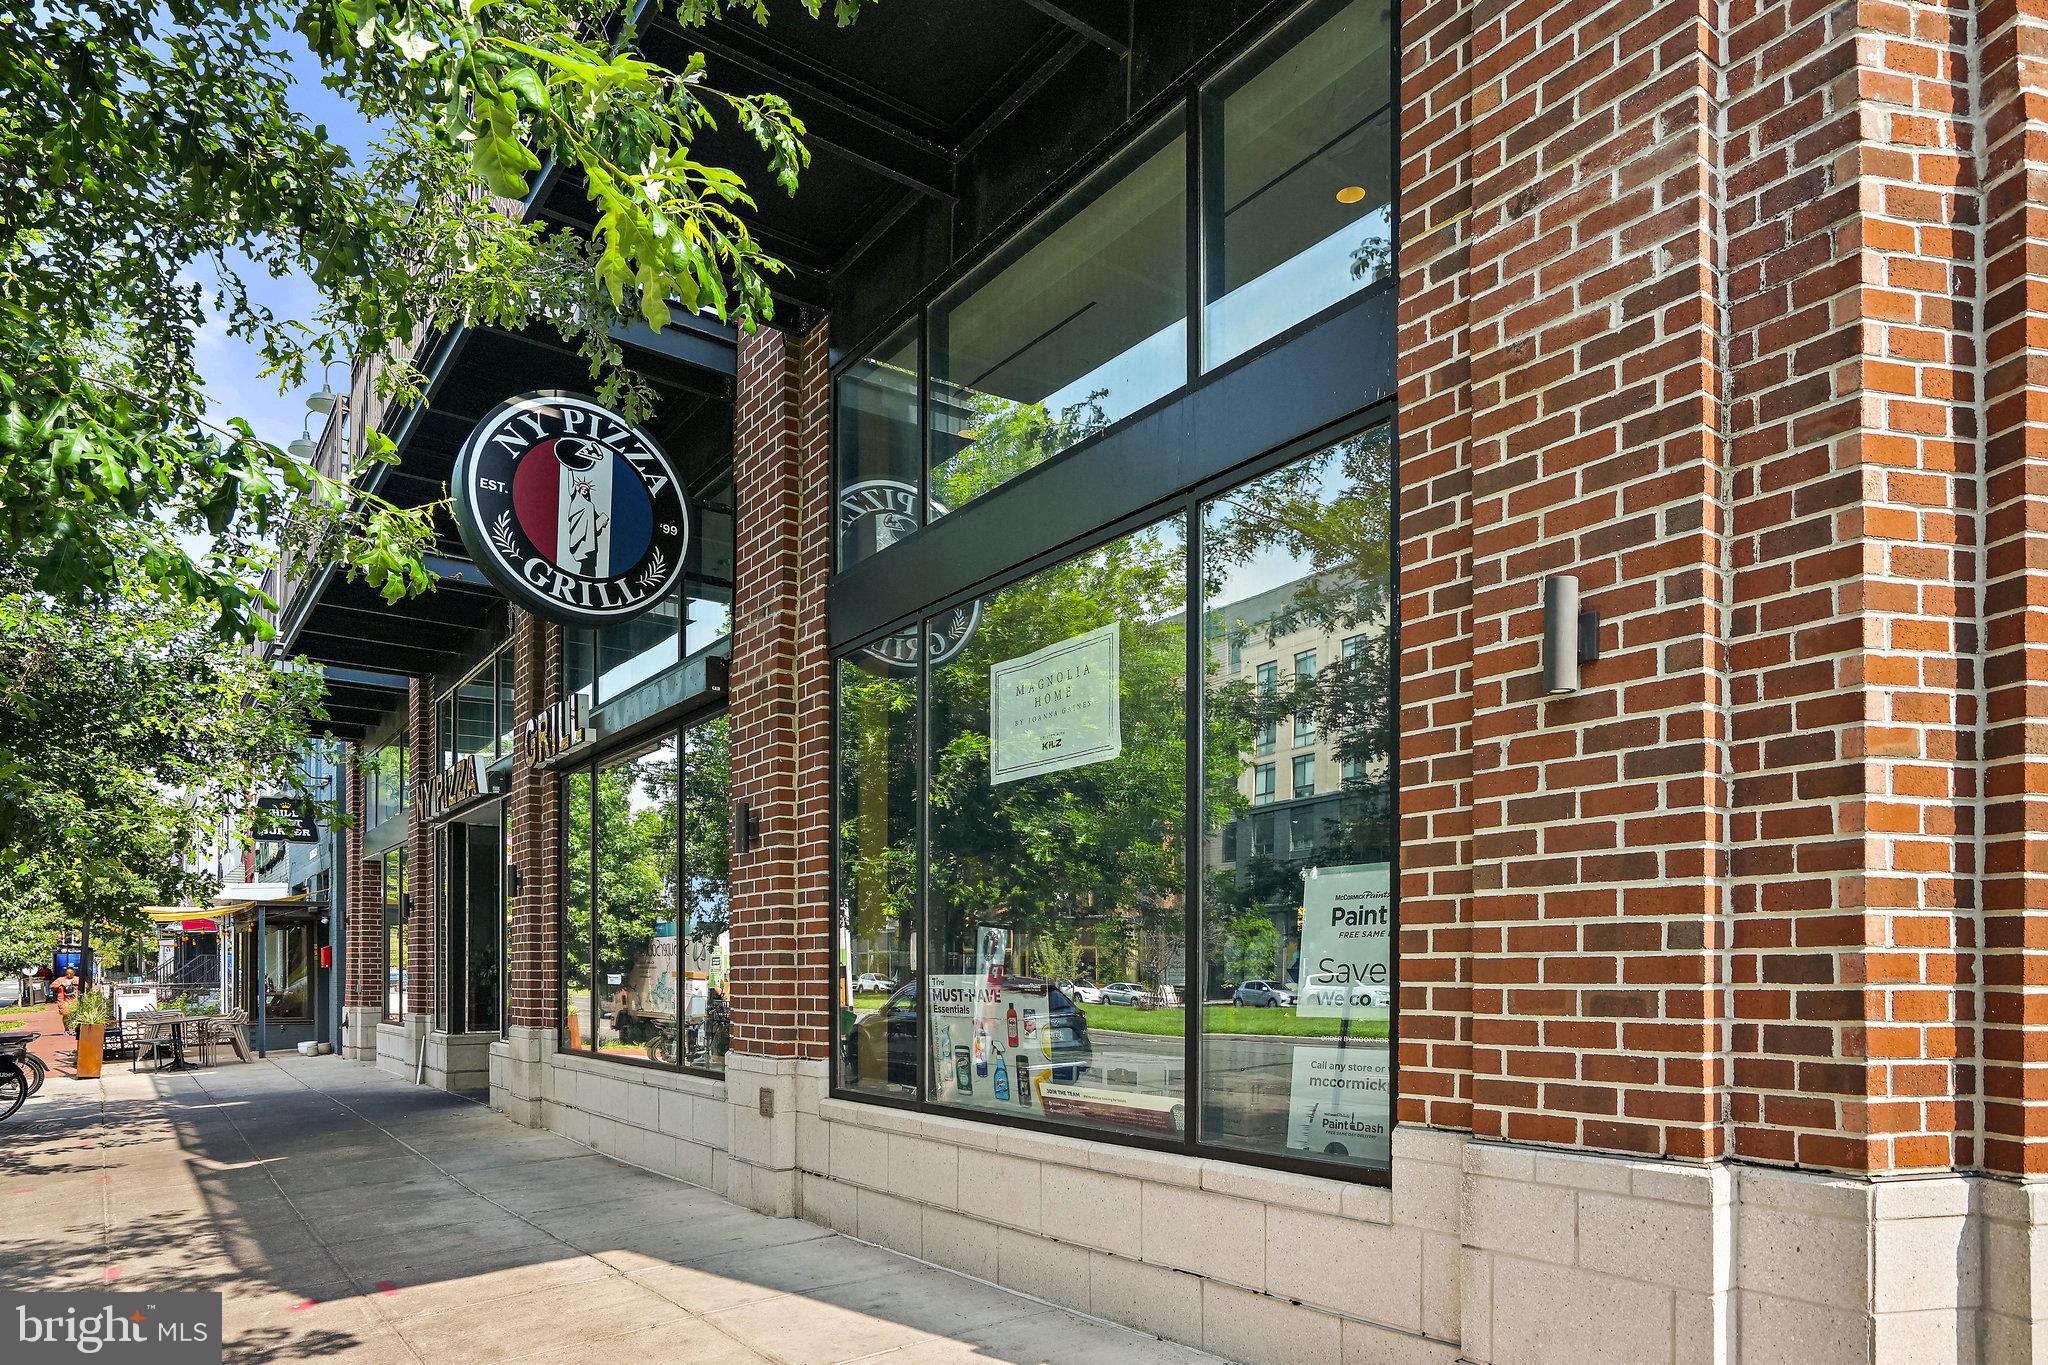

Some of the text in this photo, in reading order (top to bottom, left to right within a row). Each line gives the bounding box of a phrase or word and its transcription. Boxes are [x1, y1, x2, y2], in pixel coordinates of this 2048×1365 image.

[492, 408, 669, 499] NY PIZZA
[479, 477, 509, 494] EST.
[523, 557, 645, 608] GRILL
[1015, 664, 1091, 697] MAGNOLIA
[1034, 686, 1072, 708] HOME
[525, 693, 591, 769] GRILL
[1041, 738, 1063, 751] KILZ
[268, 808, 299, 818] HILL
[258, 827, 311, 837] BURER
[1331, 904, 1388, 927] Paint
[1338, 930, 1386, 939] FREE SAME
[1317, 957, 1387, 984] Save
[931, 977, 945, 986] The
[932, 988, 1002, 1004] MUST-HAVE
[932, 1004, 971, 1015] Essentials
[1310, 1060, 1386, 1073] Call any store or
[1309, 1076, 1389, 1092] mccormick
[1322, 1118, 1384, 1134] Paint Dash
